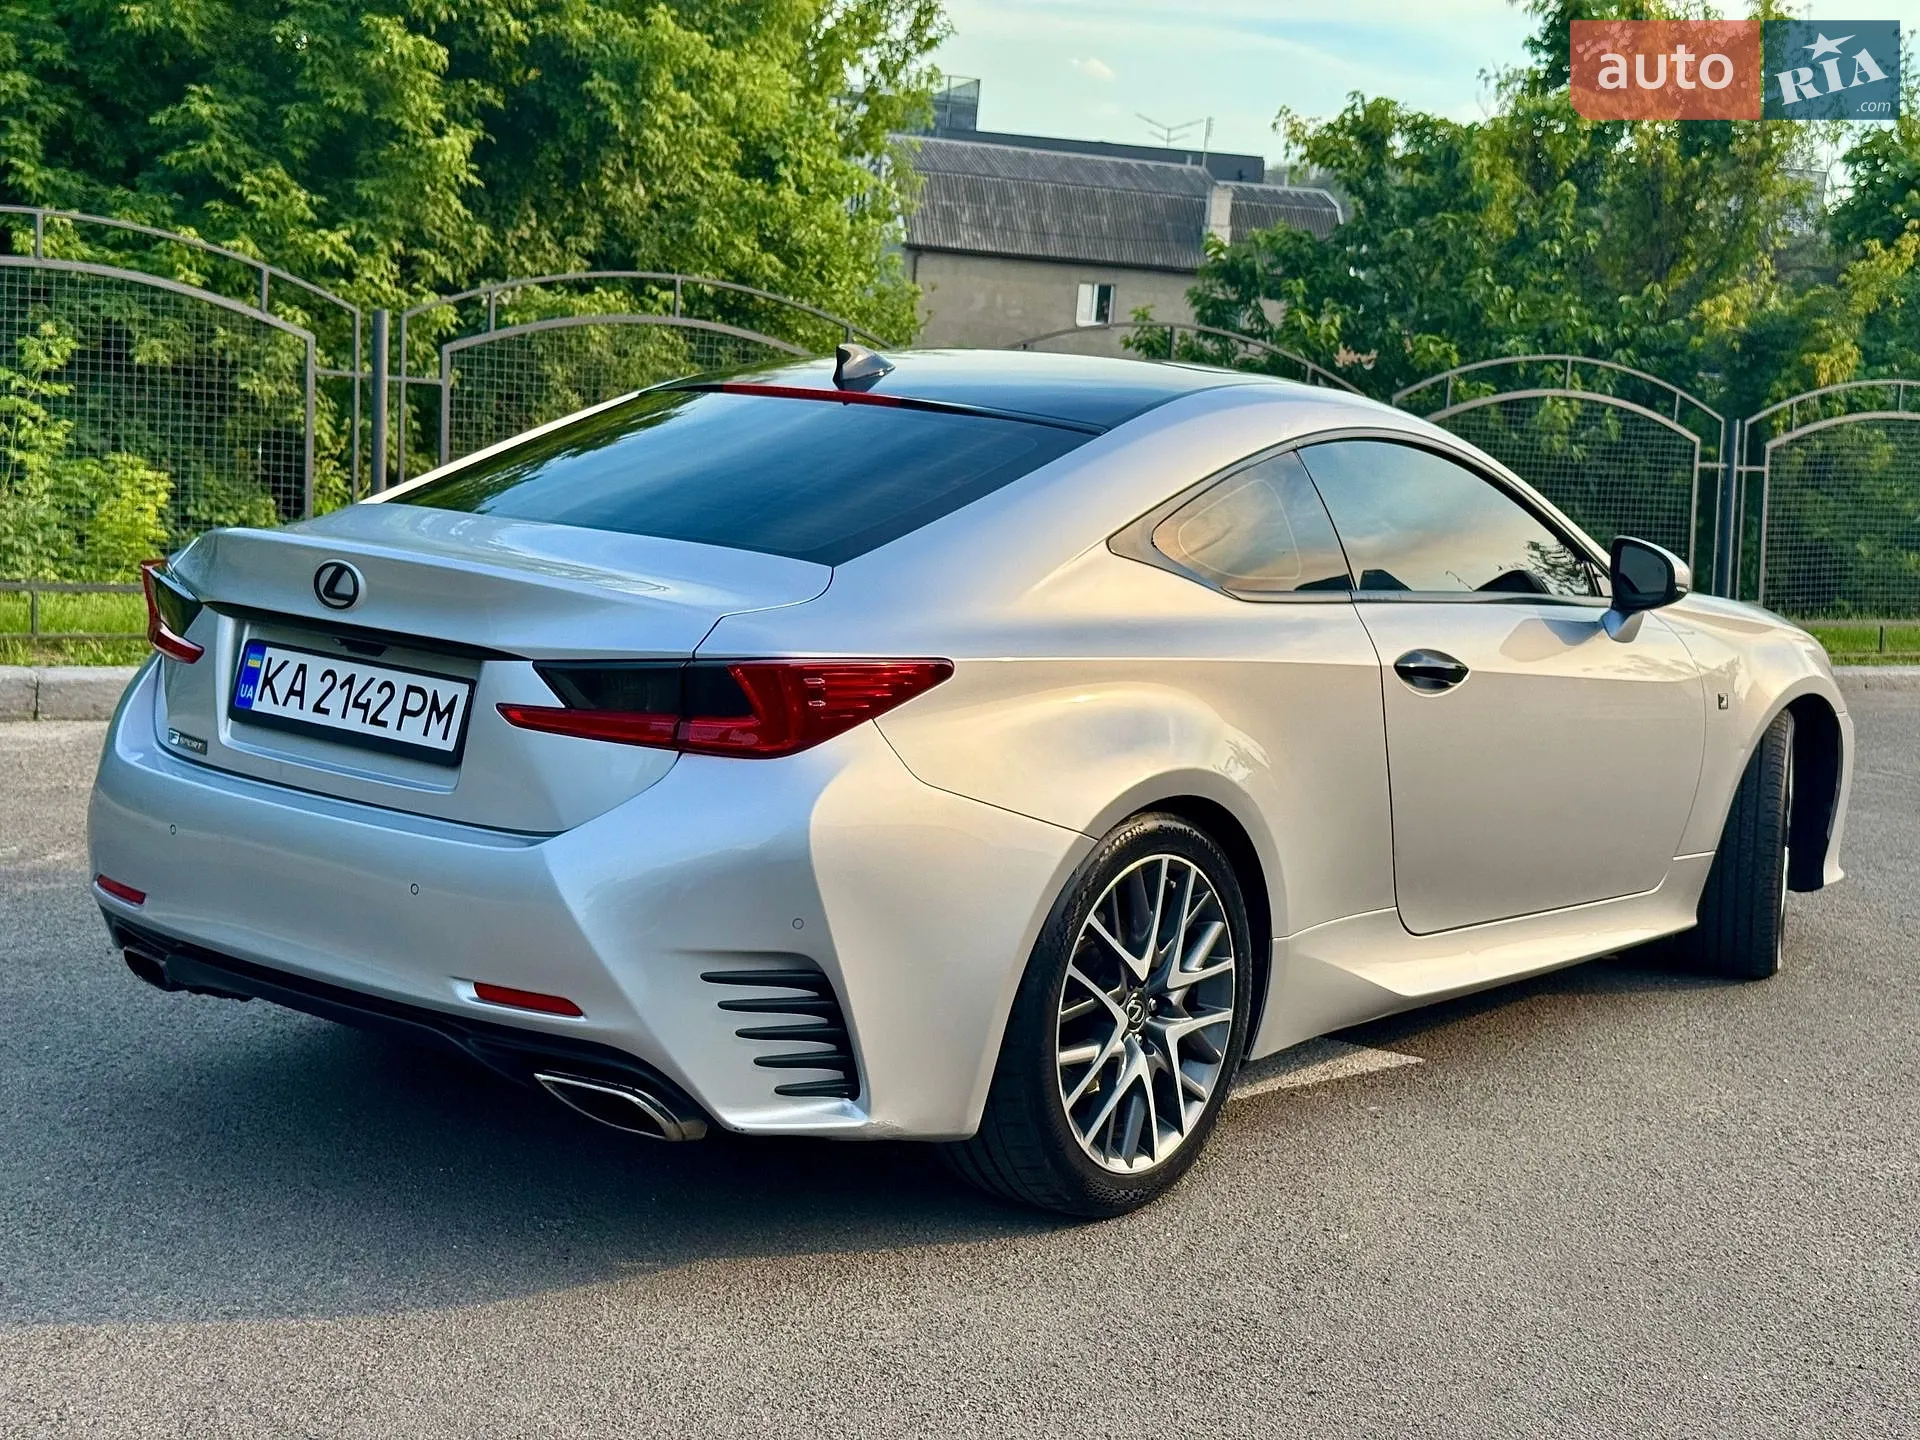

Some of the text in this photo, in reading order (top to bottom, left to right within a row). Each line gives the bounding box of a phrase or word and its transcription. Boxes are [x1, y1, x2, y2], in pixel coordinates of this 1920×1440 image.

[240, 683, 254, 699] UA
[257, 656, 458, 741] KA 2142 PM
